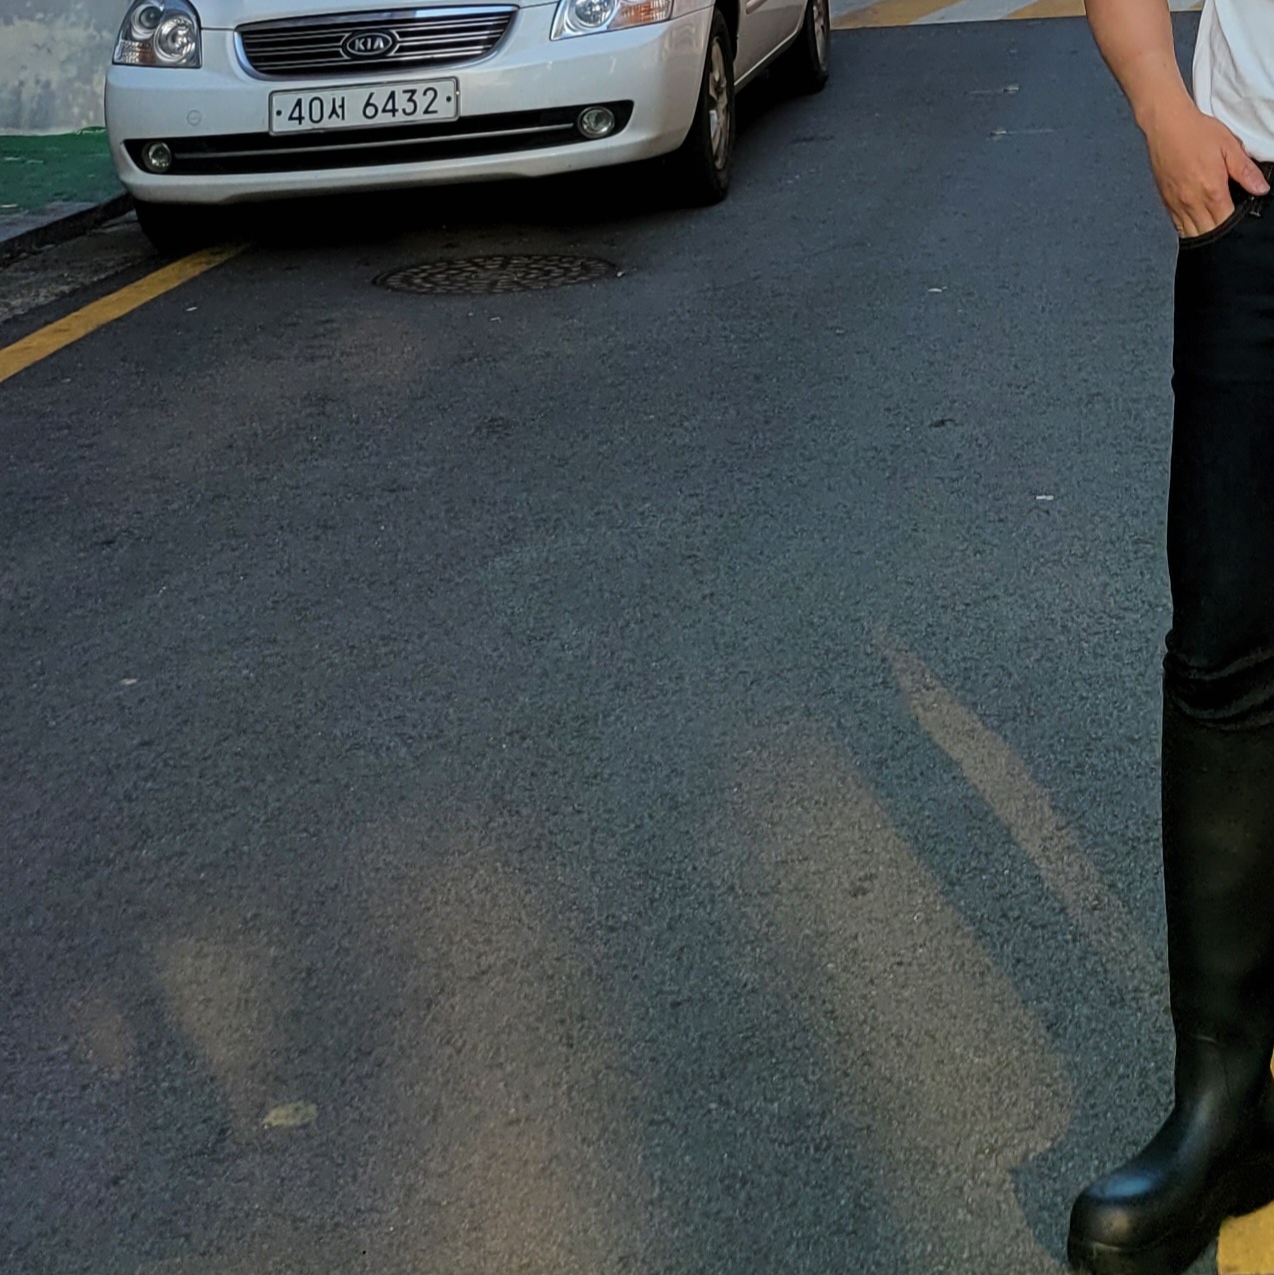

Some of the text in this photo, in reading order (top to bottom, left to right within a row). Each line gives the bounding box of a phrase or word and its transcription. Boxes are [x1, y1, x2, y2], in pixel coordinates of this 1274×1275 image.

[354, 37, 384, 52] KIA
[288, 87, 438, 125] 40서 6432
